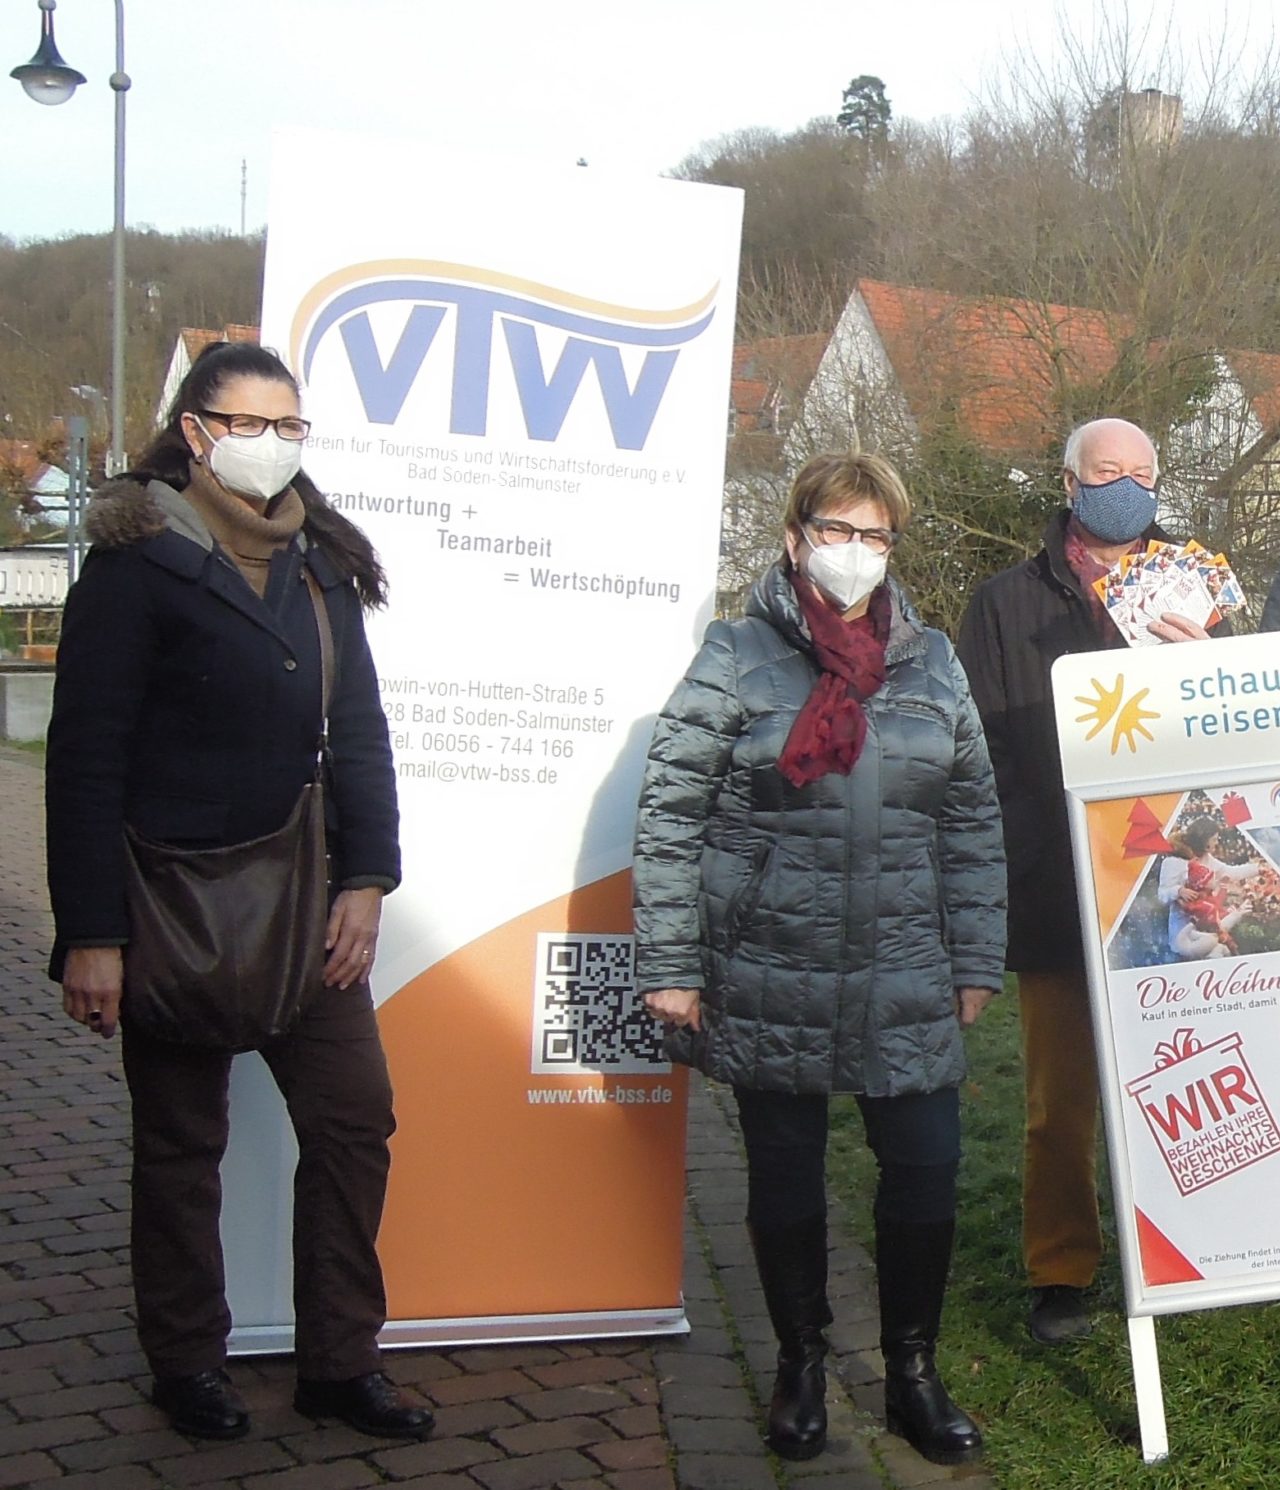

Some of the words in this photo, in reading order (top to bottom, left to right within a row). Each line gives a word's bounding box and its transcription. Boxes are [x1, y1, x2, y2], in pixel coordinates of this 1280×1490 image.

[339, 303, 681, 451] VTW
[304, 435, 345, 451] erein
[379, 439, 459, 463] Tourismus
[464, 451, 494, 465] und
[408, 463, 437, 481] Bad
[322, 491, 451, 522] rantwortung
[437, 529, 552, 558] Teamarbeit
[530, 568, 681, 603] Wertschöpfung
[378, 676, 587, 705] owin-von-Hutten-Straße
[594, 688, 604, 706] 5
[384, 702, 405, 722] 28
[412, 704, 446, 724] Bad
[453, 706, 614, 734] Soden-Salmünster
[422, 732, 480, 753] 06056
[500, 736, 533, 756] 744
[542, 738, 574, 758] 166
[399, 760, 558, 785] mail@vtw-bss.de
[1136, 975, 1190, 1007] Die
[1141, 1010, 1164, 1022] Kauf
[1168, 1008, 1177, 1018] in
[1180, 1003, 1212, 1016] deiner
[1216, 1000, 1245, 1013] Stadt,
[1248, 995, 1277, 1008] damit
[527, 1085, 673, 1105] www.vtw-bss.de
[1145, 1065, 1259, 1142] WIR
[1167, 1123, 1233, 1161] BEZAHLEN
[1234, 1106, 1266, 1129] IHRE
[1172, 1119, 1274, 1174] WEIHNACHTS
[1180, 1132, 1280, 1189] GESCHENKE
[1199, 1255, 1212, 1264] Die
[1214, 1251, 1245, 1263] Ziehung
[1248, 1247, 1270, 1258] findet
[1273, 1246, 1280, 1254] in
[1251, 1260, 1264, 1268] der
